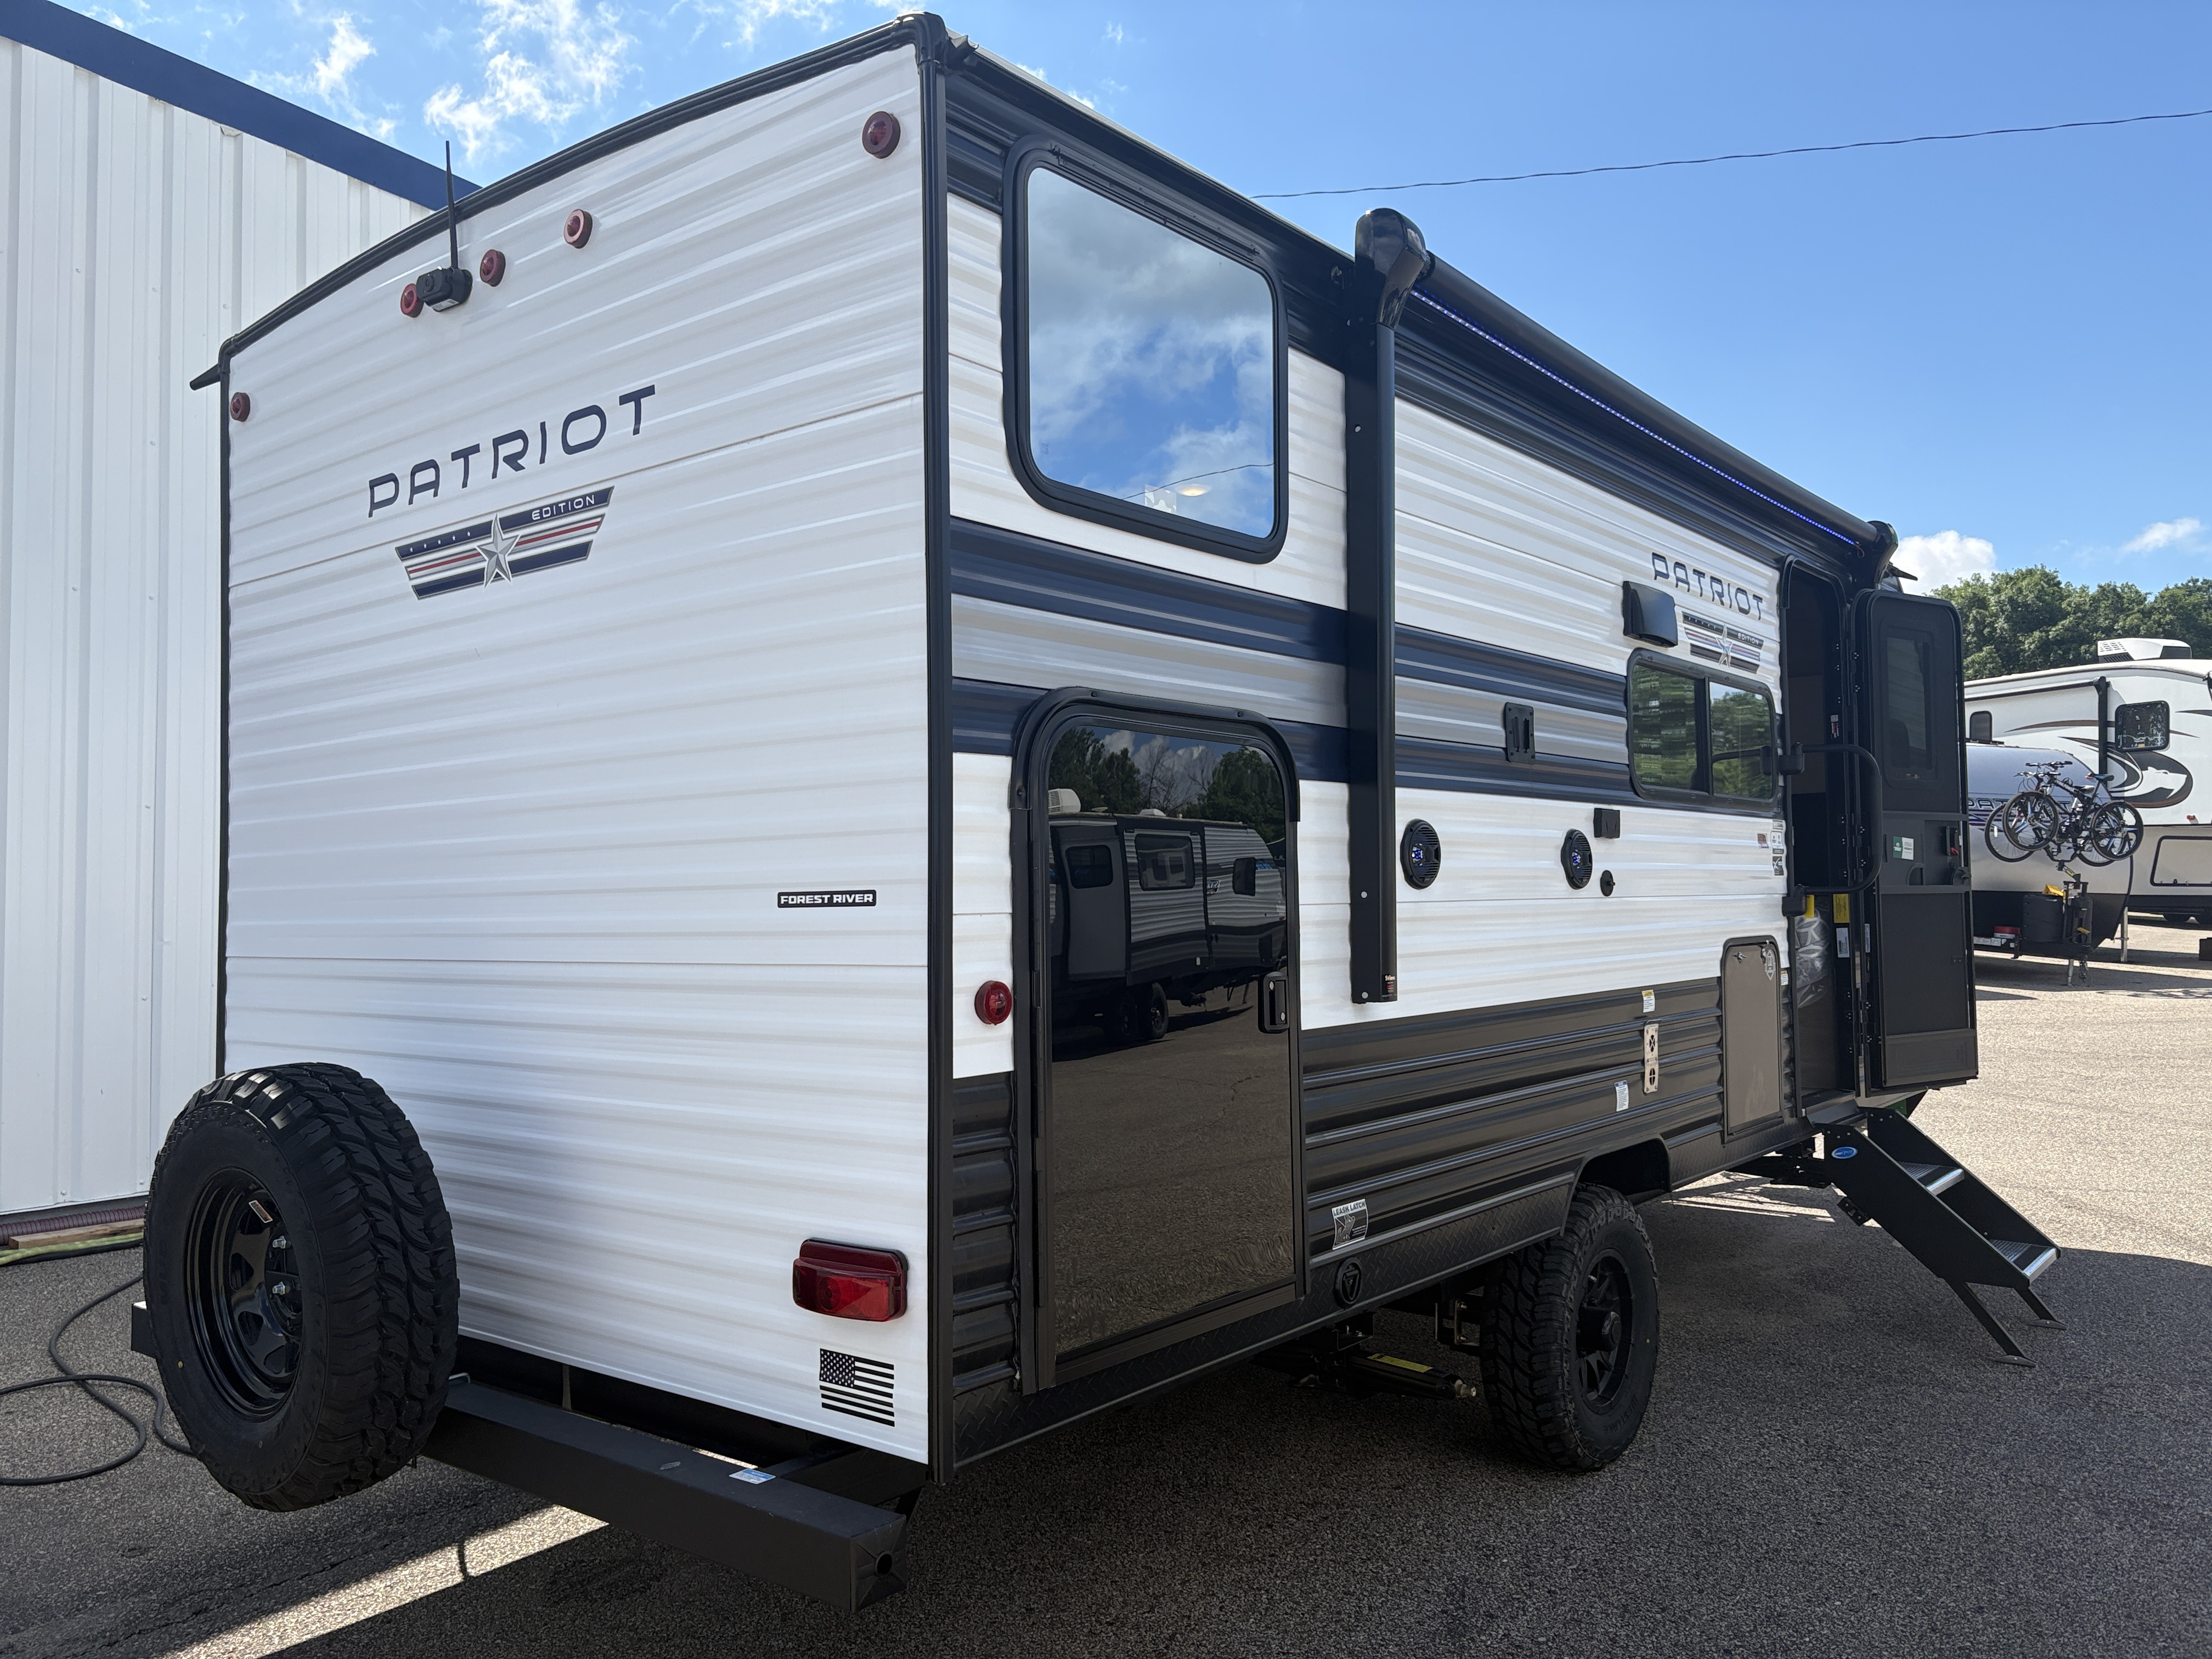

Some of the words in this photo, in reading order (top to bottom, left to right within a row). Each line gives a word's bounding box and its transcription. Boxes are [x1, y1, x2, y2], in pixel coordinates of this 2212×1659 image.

[368, 384, 656, 518] PATRIOT
[531, 495, 596, 521] EDITION
[1652, 552, 1763, 620] PATRIOT
[1737, 633, 1759, 646] EDITION
[780, 895, 831, 904] FOREST
[833, 893, 873, 903] RIVER
[1333, 1205, 1350, 1216] LEASH
[1350, 1201, 1365, 1211] LATCH
